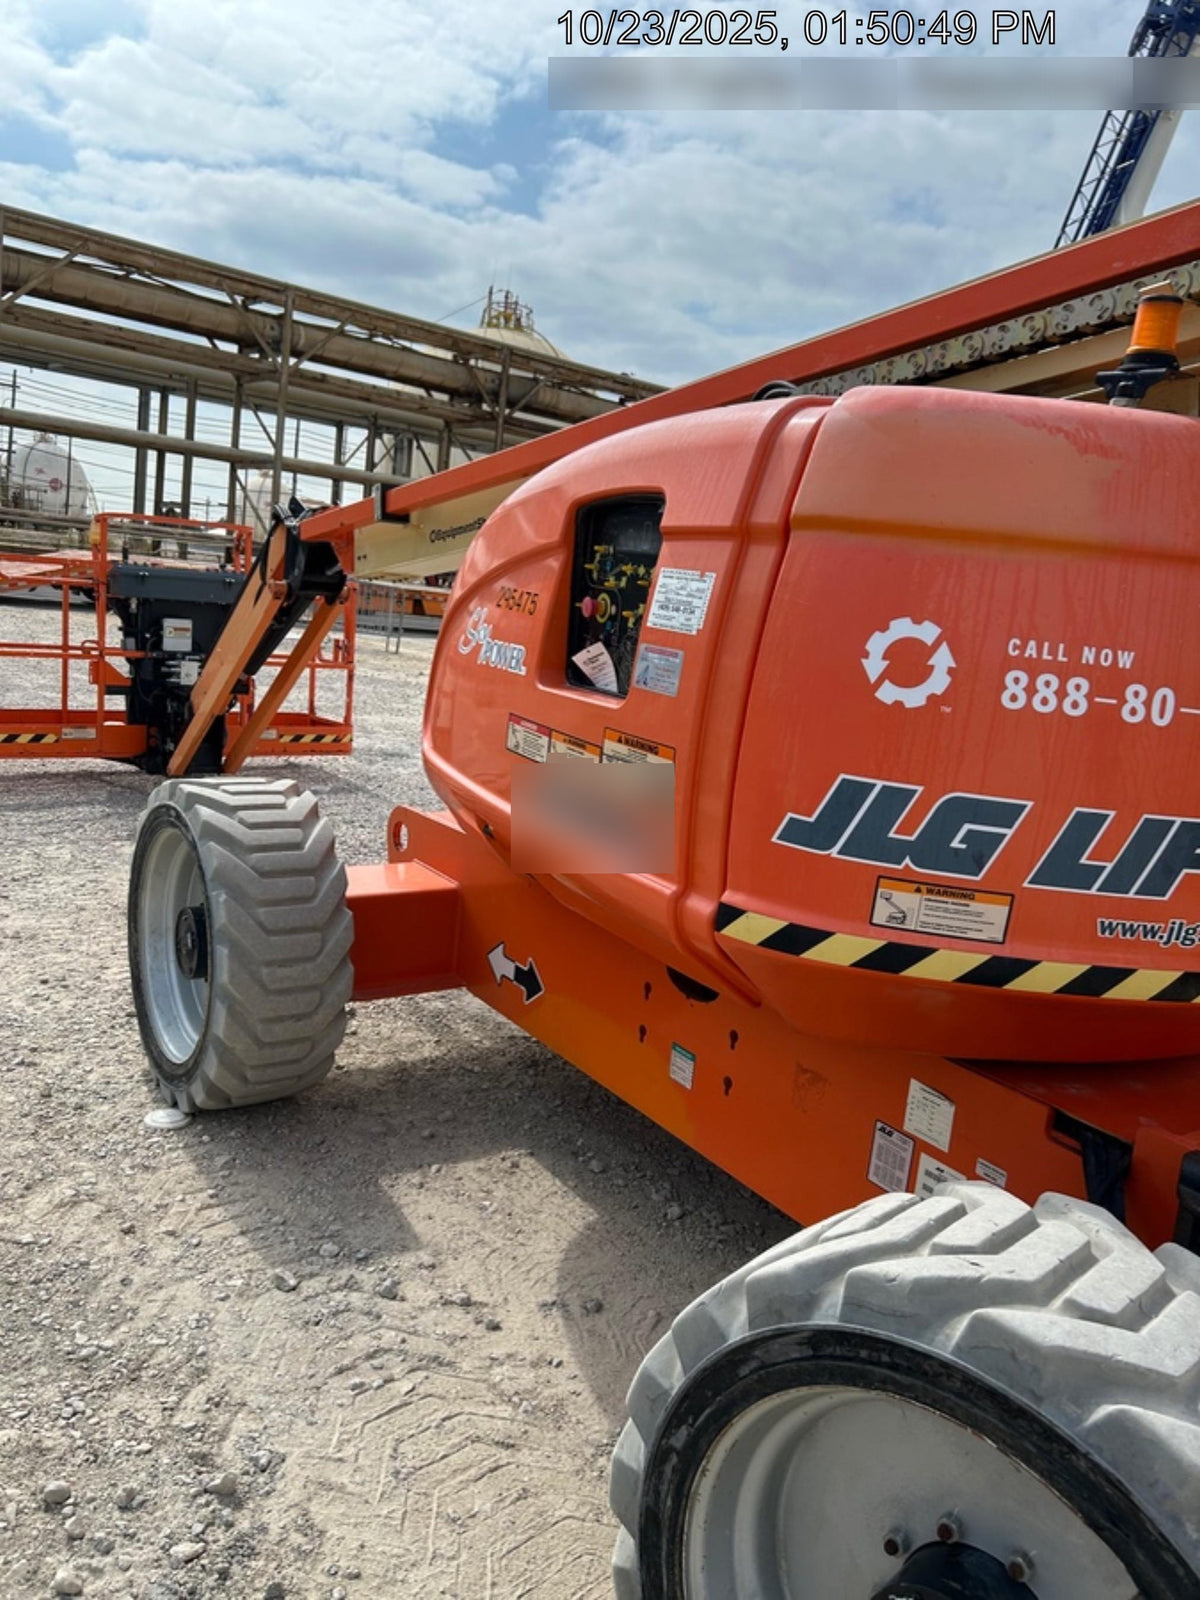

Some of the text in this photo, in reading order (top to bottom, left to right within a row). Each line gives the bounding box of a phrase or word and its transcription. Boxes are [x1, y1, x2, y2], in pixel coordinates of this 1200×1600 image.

[496, 585, 540, 616] 295475
[477, 638, 527, 676] POWER
[1007, 637, 1135, 670] CALL NOW
[771, 773, 1035, 881] JLG
[925, 886, 976, 901] WARNING
[1097, 917, 1200, 947] www.jlg
